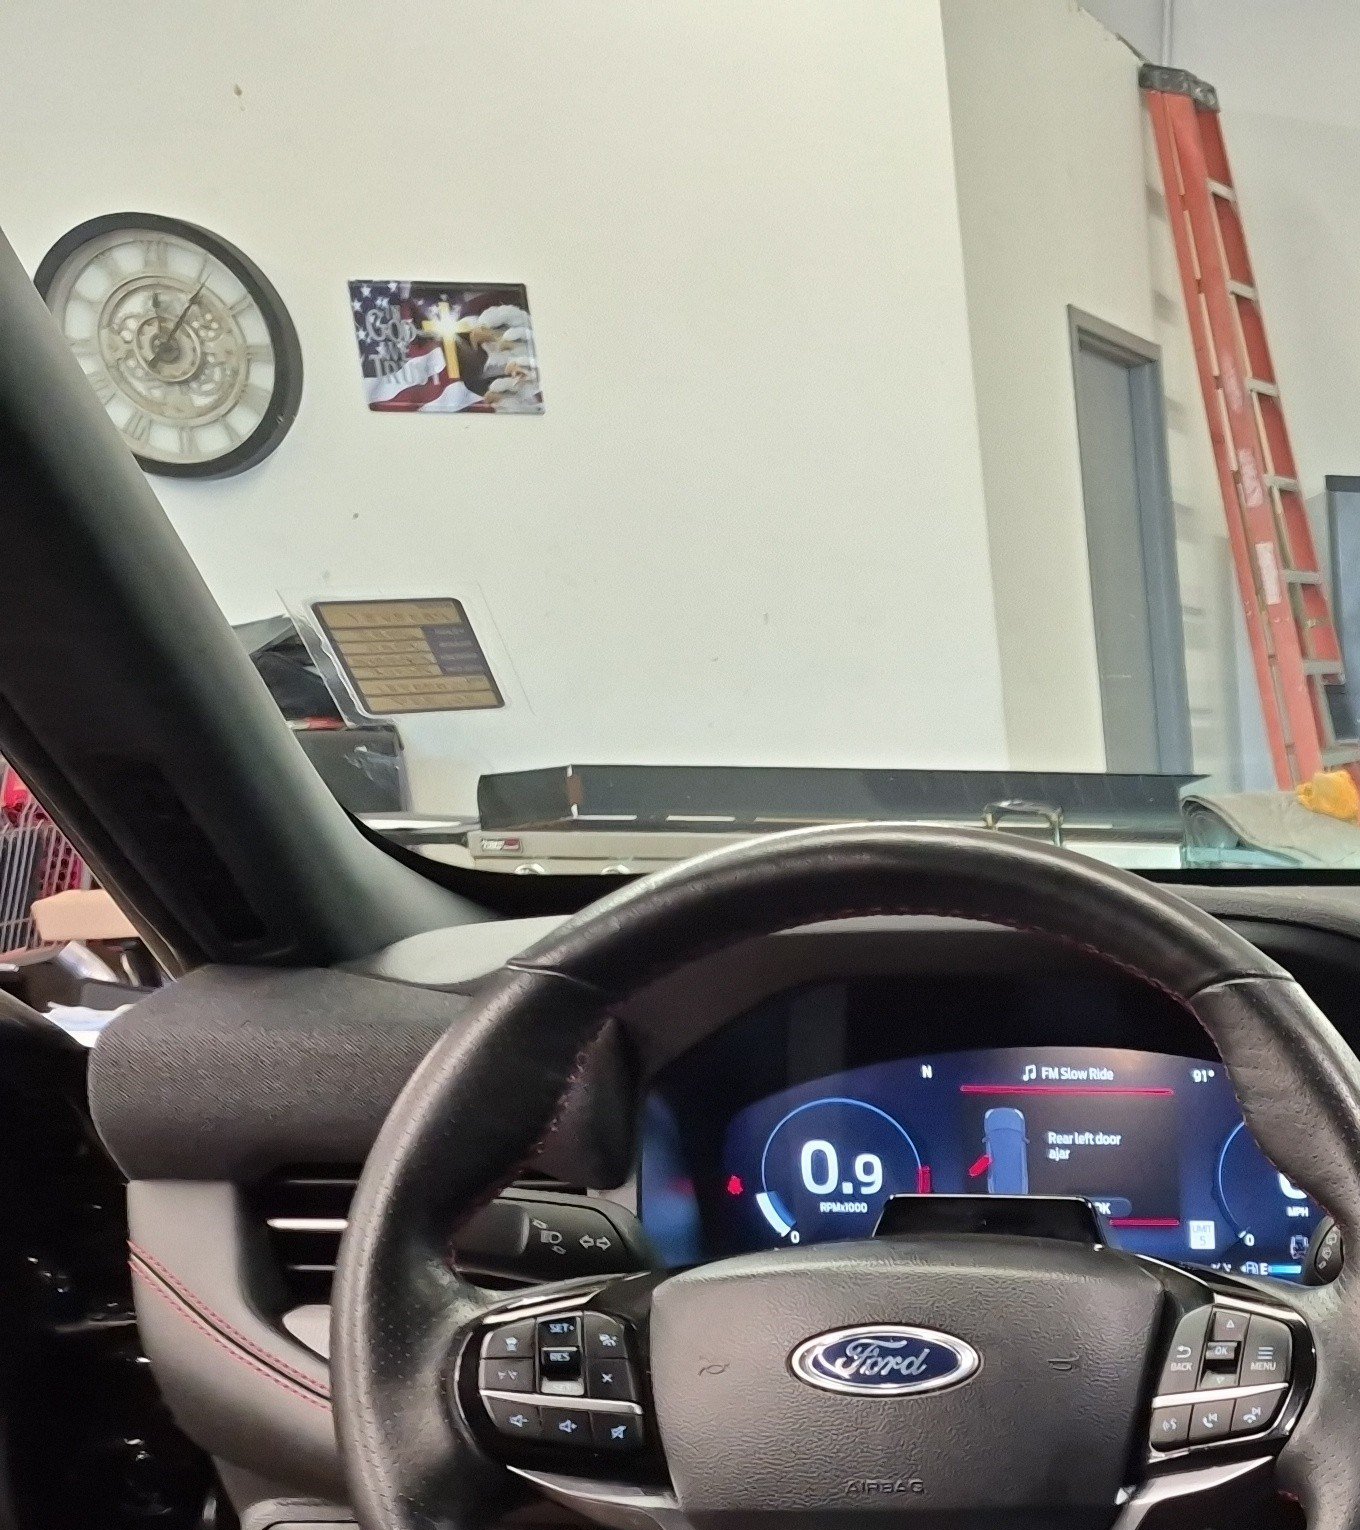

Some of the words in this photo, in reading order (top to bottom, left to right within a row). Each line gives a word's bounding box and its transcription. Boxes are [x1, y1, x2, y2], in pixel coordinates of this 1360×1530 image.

[921, 1065, 932, 1078] N
[1041, 1068, 1060, 1080] FM
[1061, 1068, 1088, 1080] Slow
[1088, 1068, 1114, 1081] Ride
[1048, 1132, 1073, 1145] Rear
[1074, 1132, 1094, 1145] left
[1095, 1133, 1121, 1145] door
[1049, 1148, 1070, 1161] ajar
[801, 1139, 883, 1195] 0.9
[1287, 1206, 1309, 1217] MPH
[1192, 1224, 1211, 1233] LIMIT
[1260, 1262, 1269, 1275] E
[834, 1338, 931, 1377] Ford
[1214, 1347, 1229, 1355] OK
[1170, 1362, 1193, 1371] BACK
[1250, 1362, 1277, 1371] MENU
[846, 1479, 925, 1495] AIRBAG
